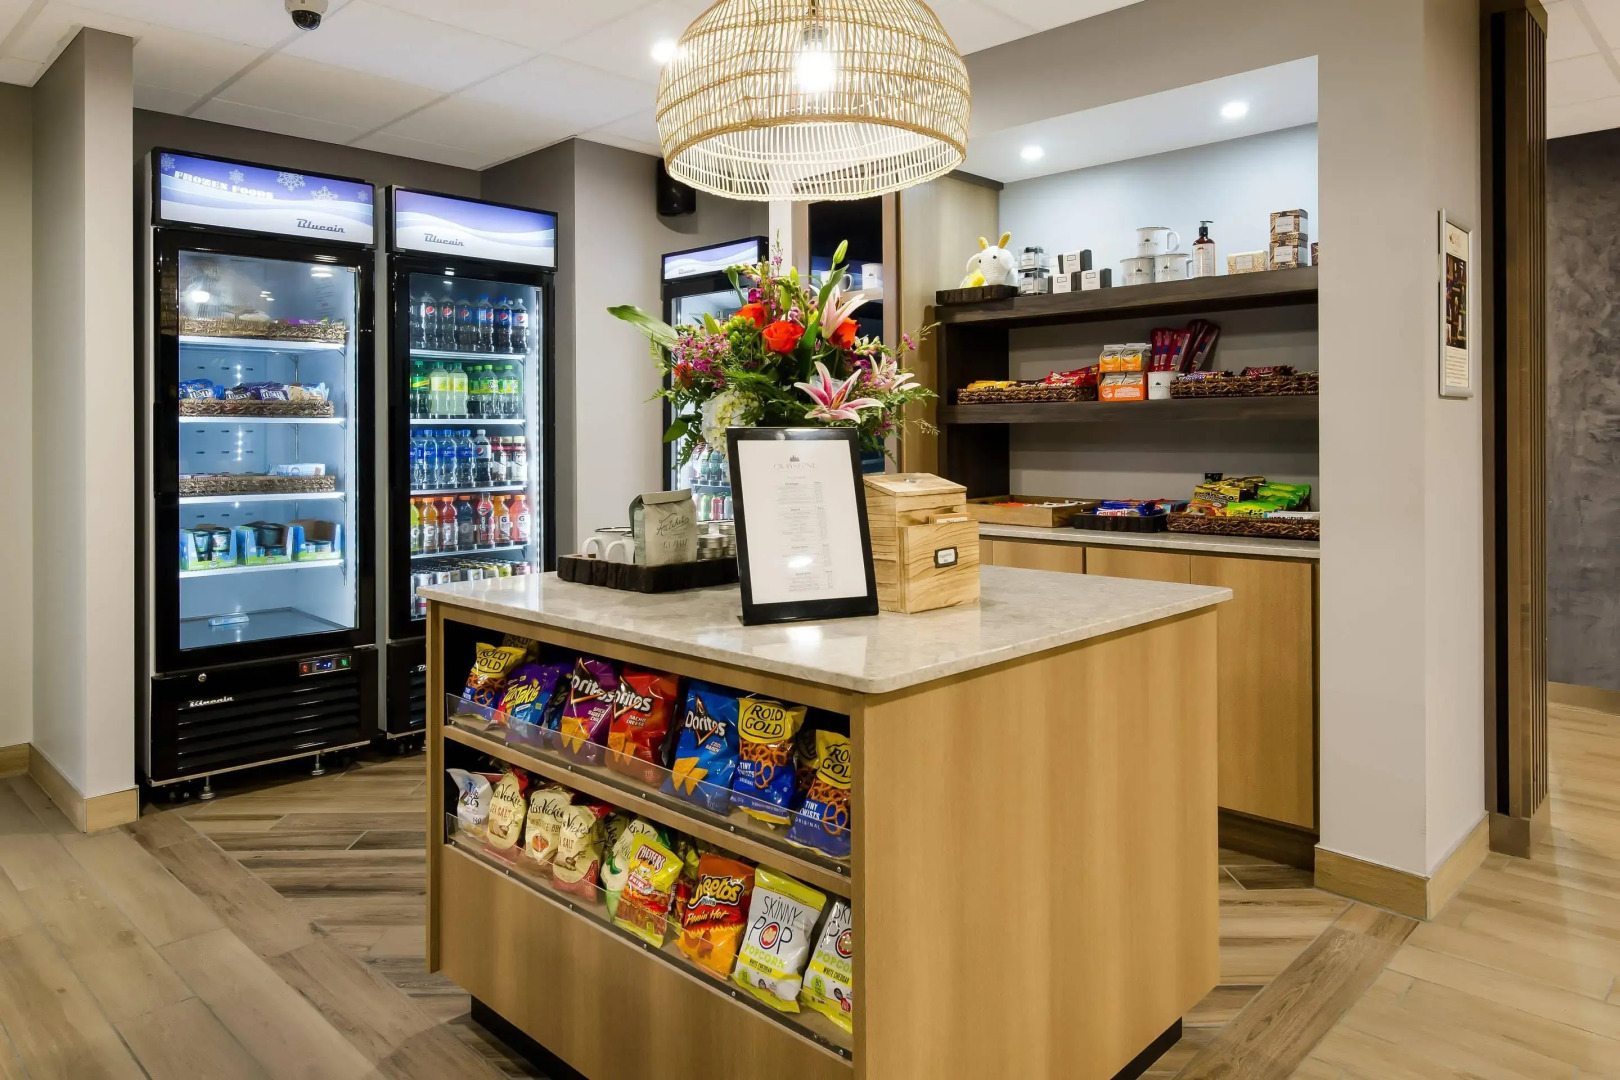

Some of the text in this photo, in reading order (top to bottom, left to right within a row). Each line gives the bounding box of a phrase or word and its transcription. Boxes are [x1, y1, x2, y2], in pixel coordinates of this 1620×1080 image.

[571, 674, 614, 703] oritos
[615, 690, 653, 712] oritos
[750, 704, 783, 722] ROLD
[685, 710, 727, 737] Doritos
[745, 716, 783, 736] GOLD
[740, 761, 751, 770] TINY
[829, 748, 850, 763] RO
[822, 758, 850, 778] GOL
[804, 800, 818, 811] TINY
[795, 816, 821, 830] ORIGINAL
[689, 878, 742, 905] eetos
[710, 908, 729, 920] Hot
[762, 895, 802, 926] SKINNY
[748, 916, 793, 955] POP
[743, 942, 786, 969] POPCORN
[815, 950, 851, 974] POPCO
[823, 966, 850, 985] WHITE CHEDDAR
